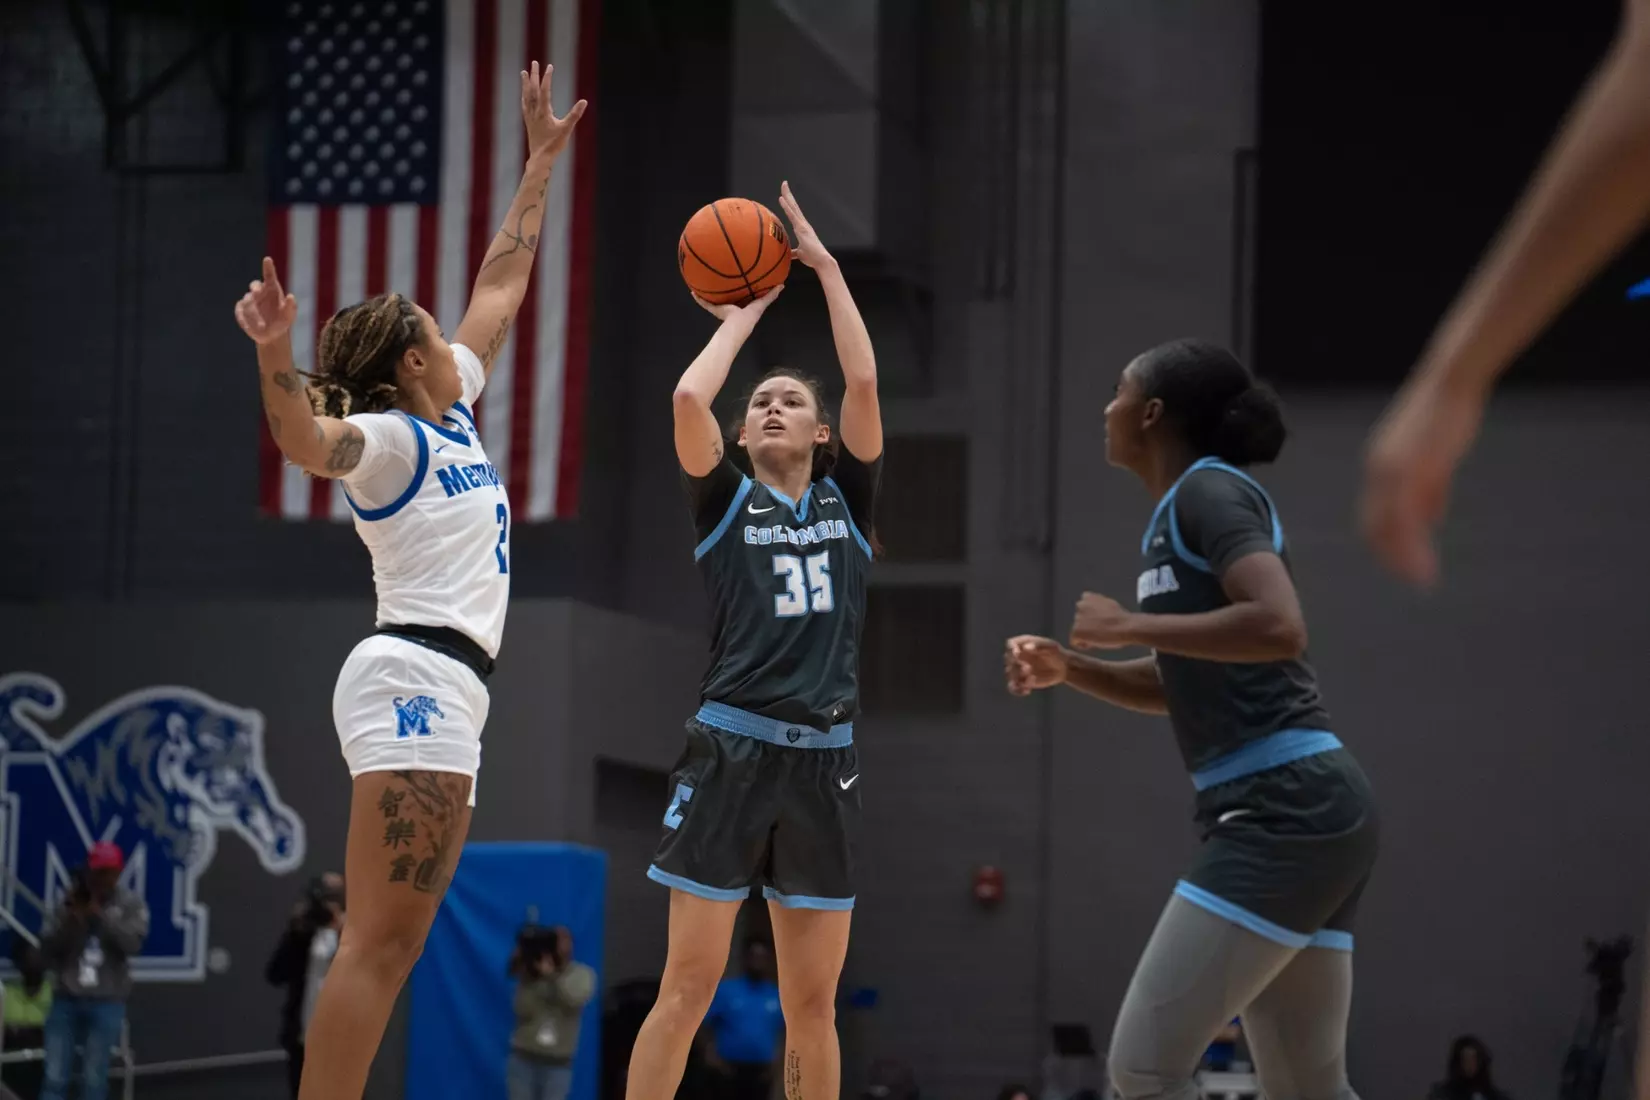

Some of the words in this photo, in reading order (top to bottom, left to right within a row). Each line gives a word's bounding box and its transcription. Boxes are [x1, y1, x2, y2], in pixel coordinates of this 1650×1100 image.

[744, 519, 849, 546] COLUMBIA
[772, 549, 835, 618] 35
[396, 706, 432, 738] M
